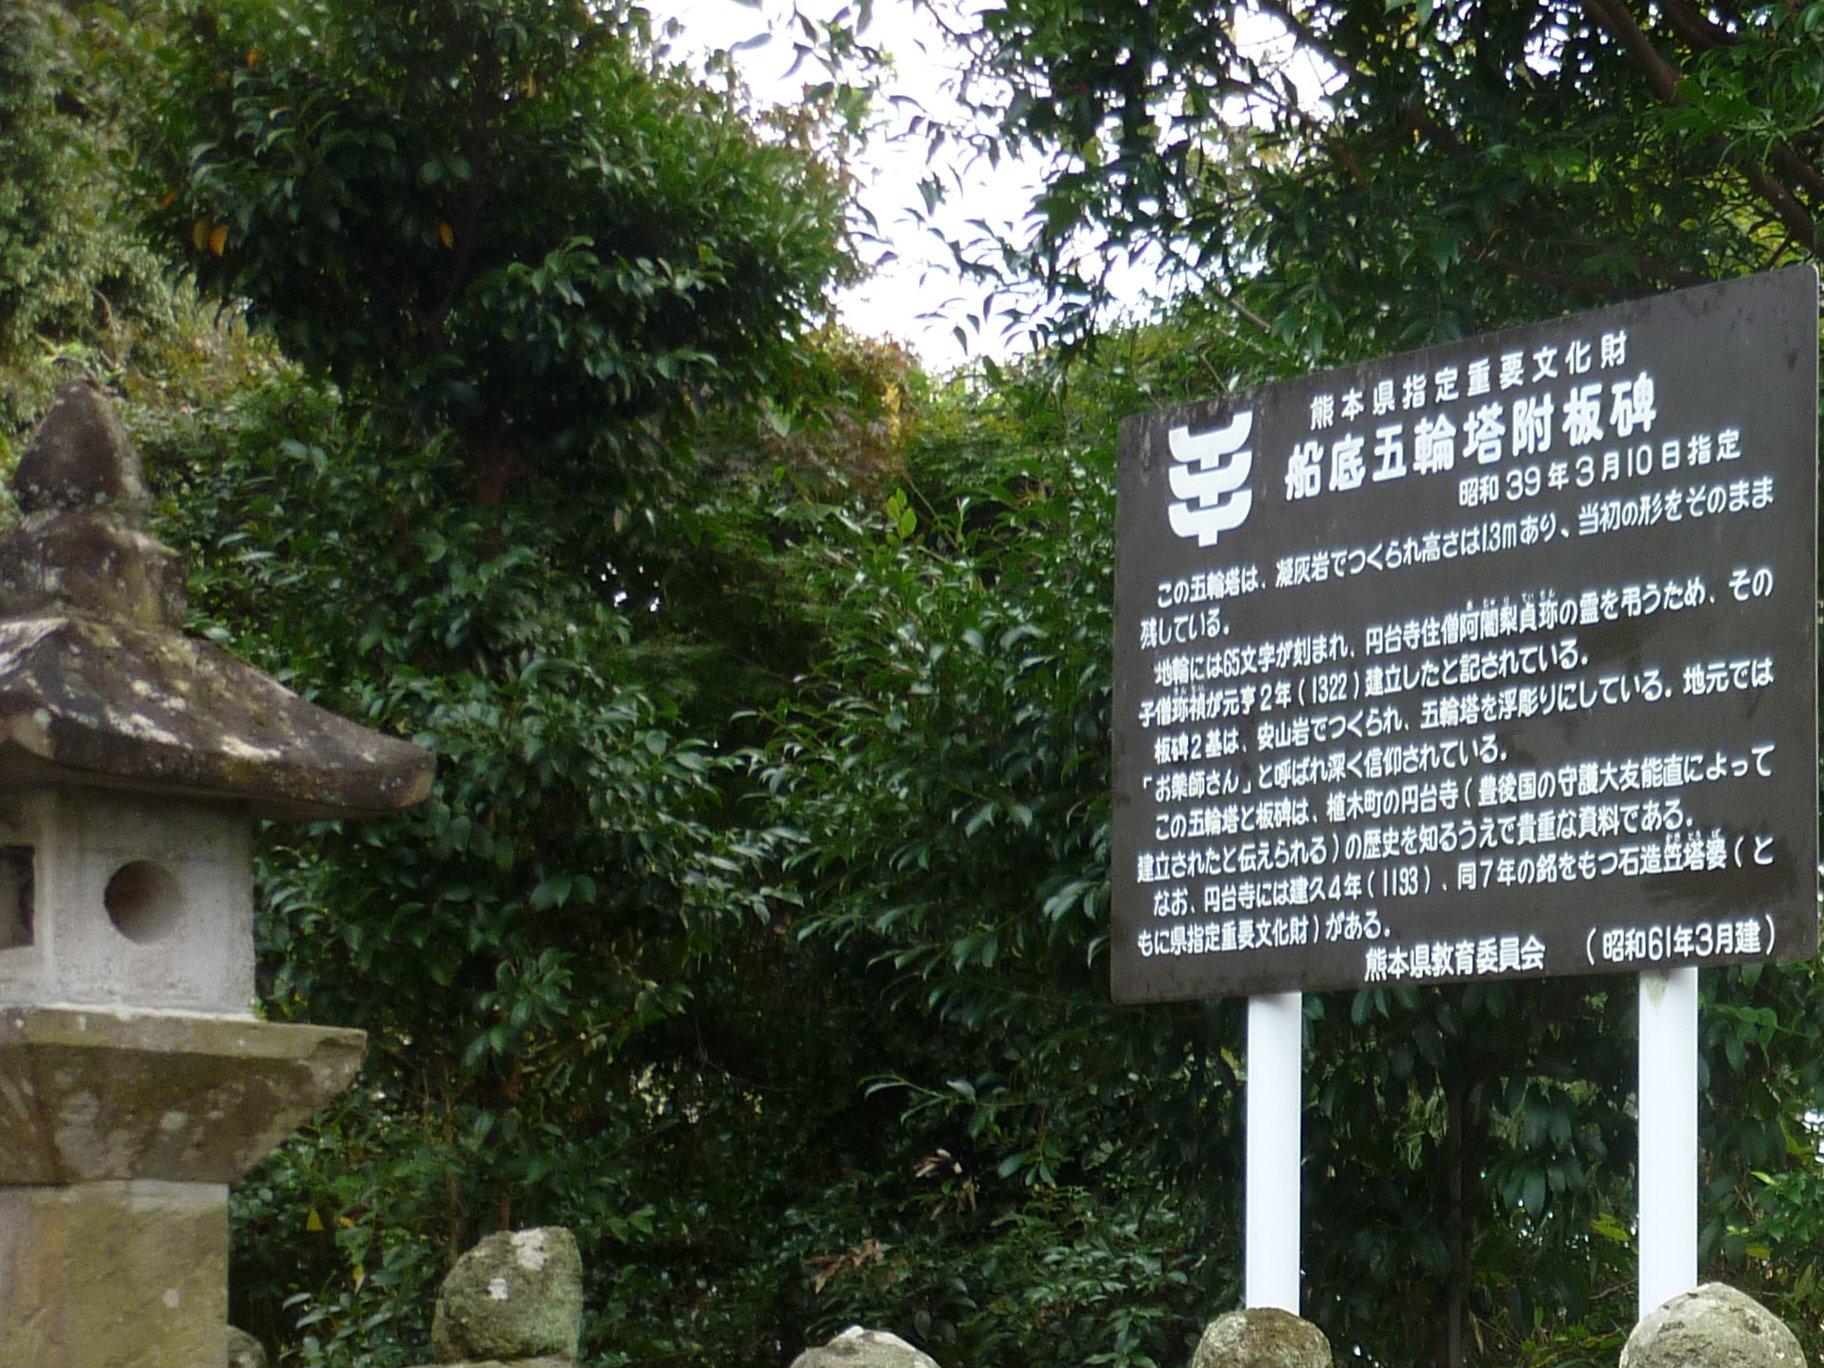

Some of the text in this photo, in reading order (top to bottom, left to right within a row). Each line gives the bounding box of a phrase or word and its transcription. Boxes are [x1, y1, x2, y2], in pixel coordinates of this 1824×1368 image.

[1310, 329, 1628, 430] 熊本県指定重要文化財
[1284, 370, 1657, 501] 船底五輪塔附板碑
[1458, 428, 1742, 508] 昭和39年3月10日指定
[1139, 607, 1230, 650] 残している。
[1364, 914, 1776, 983] 熊本県教育委員会 （昭和61年3月建）
